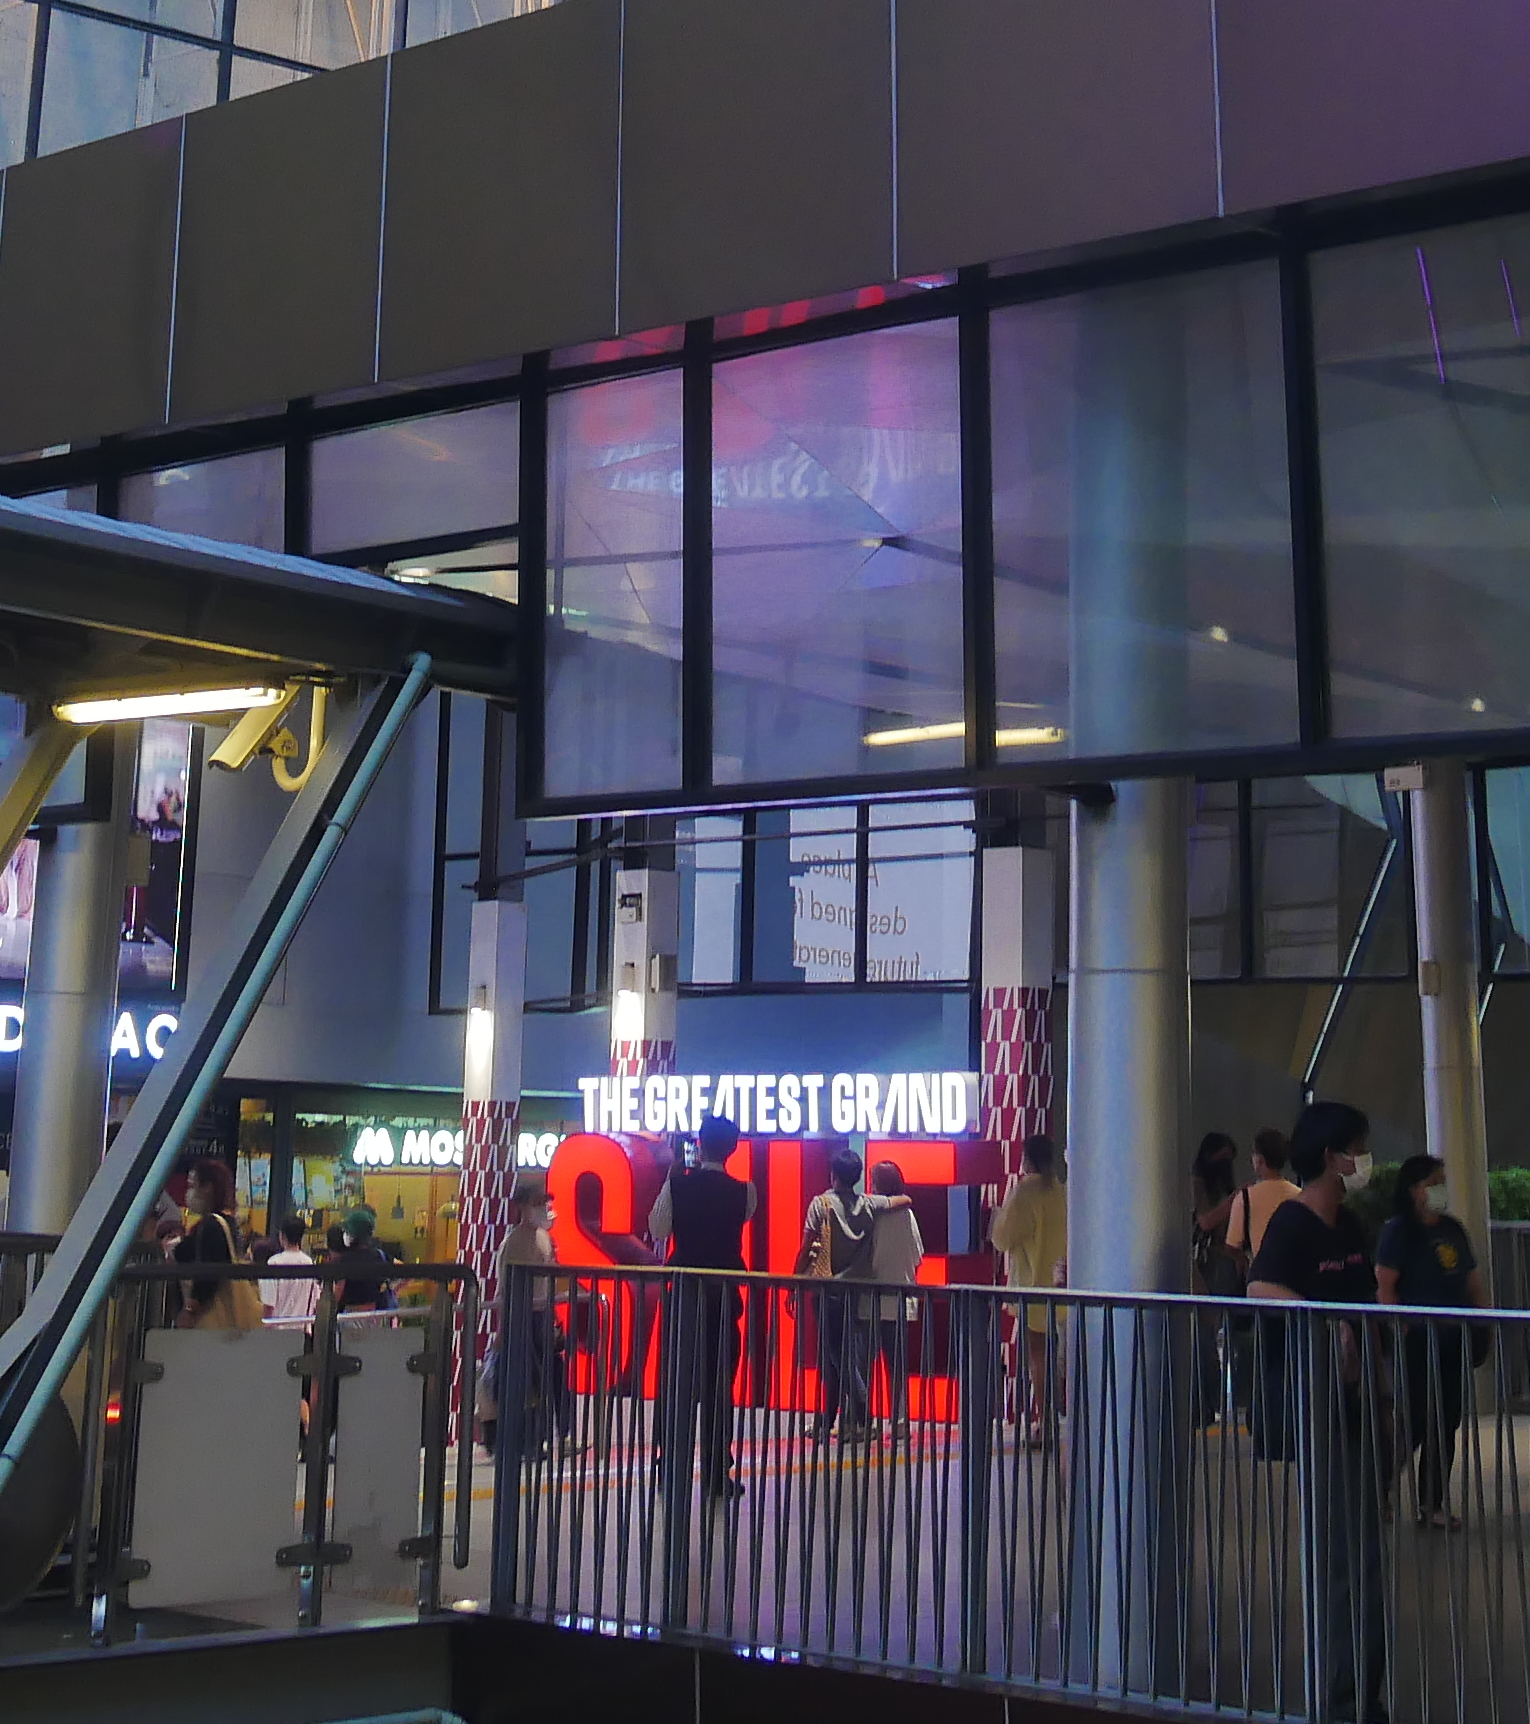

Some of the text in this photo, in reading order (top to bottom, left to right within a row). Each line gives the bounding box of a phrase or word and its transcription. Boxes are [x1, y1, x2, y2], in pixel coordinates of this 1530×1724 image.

[578, 1072, 967, 1134] THE GREATEST GRAND
[547, 1133, 957, 1424] SLE
